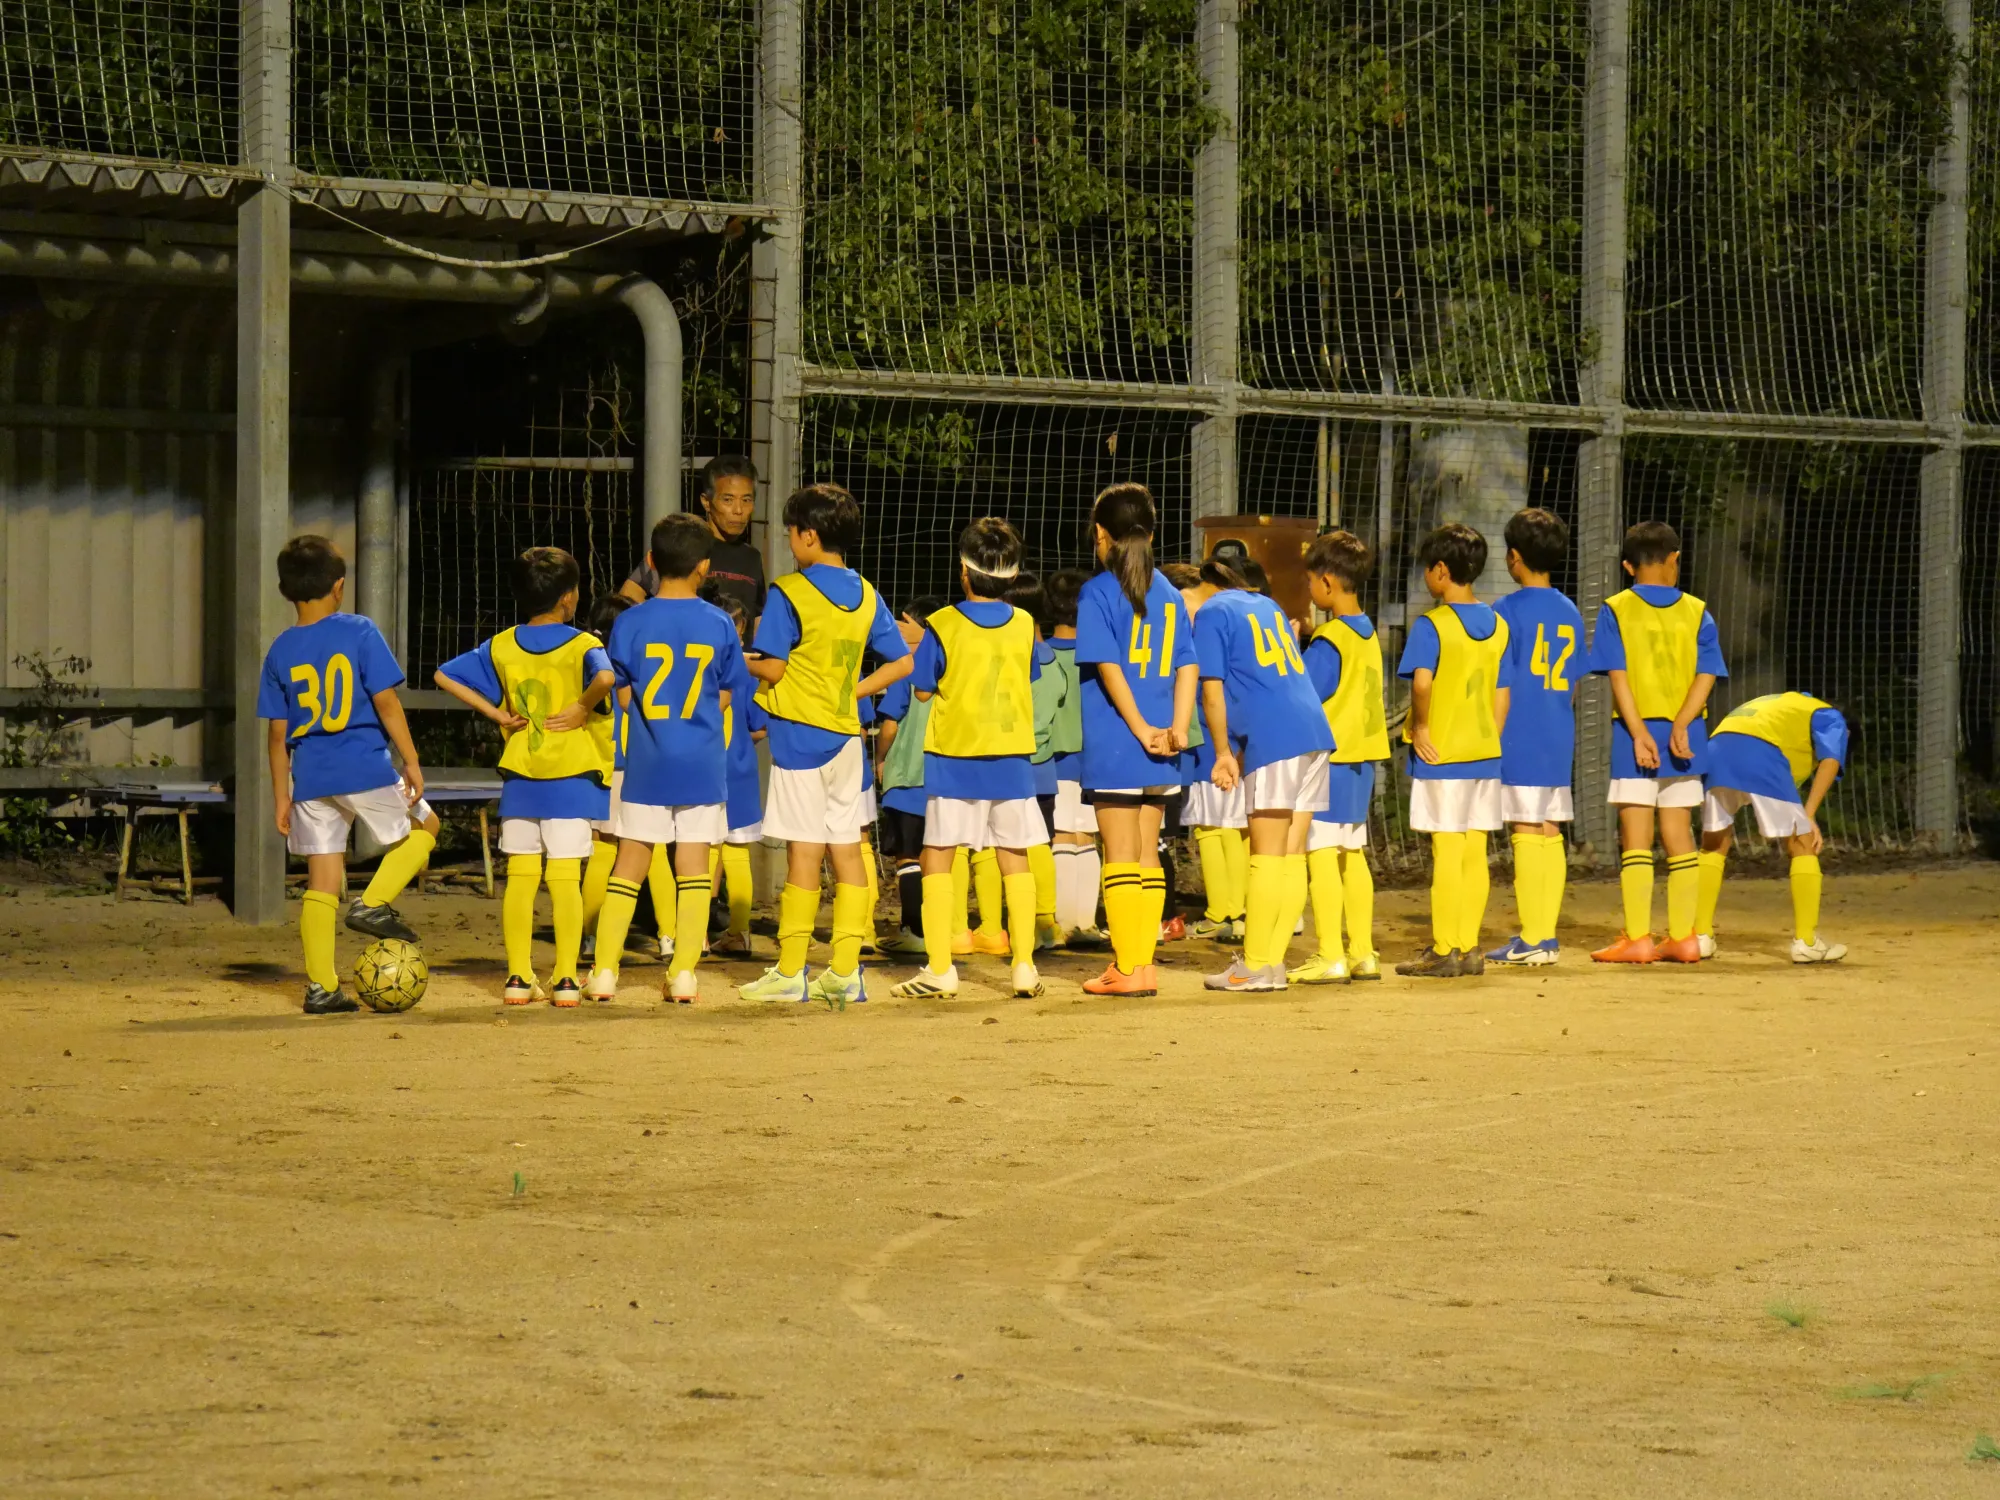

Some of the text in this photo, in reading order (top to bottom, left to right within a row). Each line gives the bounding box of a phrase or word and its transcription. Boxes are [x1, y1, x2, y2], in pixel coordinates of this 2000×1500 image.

[831, 639, 861, 715] 7
[1129, 603, 1176, 678] 41
[1247, 611, 1305, 676] 46
[1530, 623, 1575, 691] 42
[290, 653, 353, 738] 30
[643, 643, 714, 719] 27
